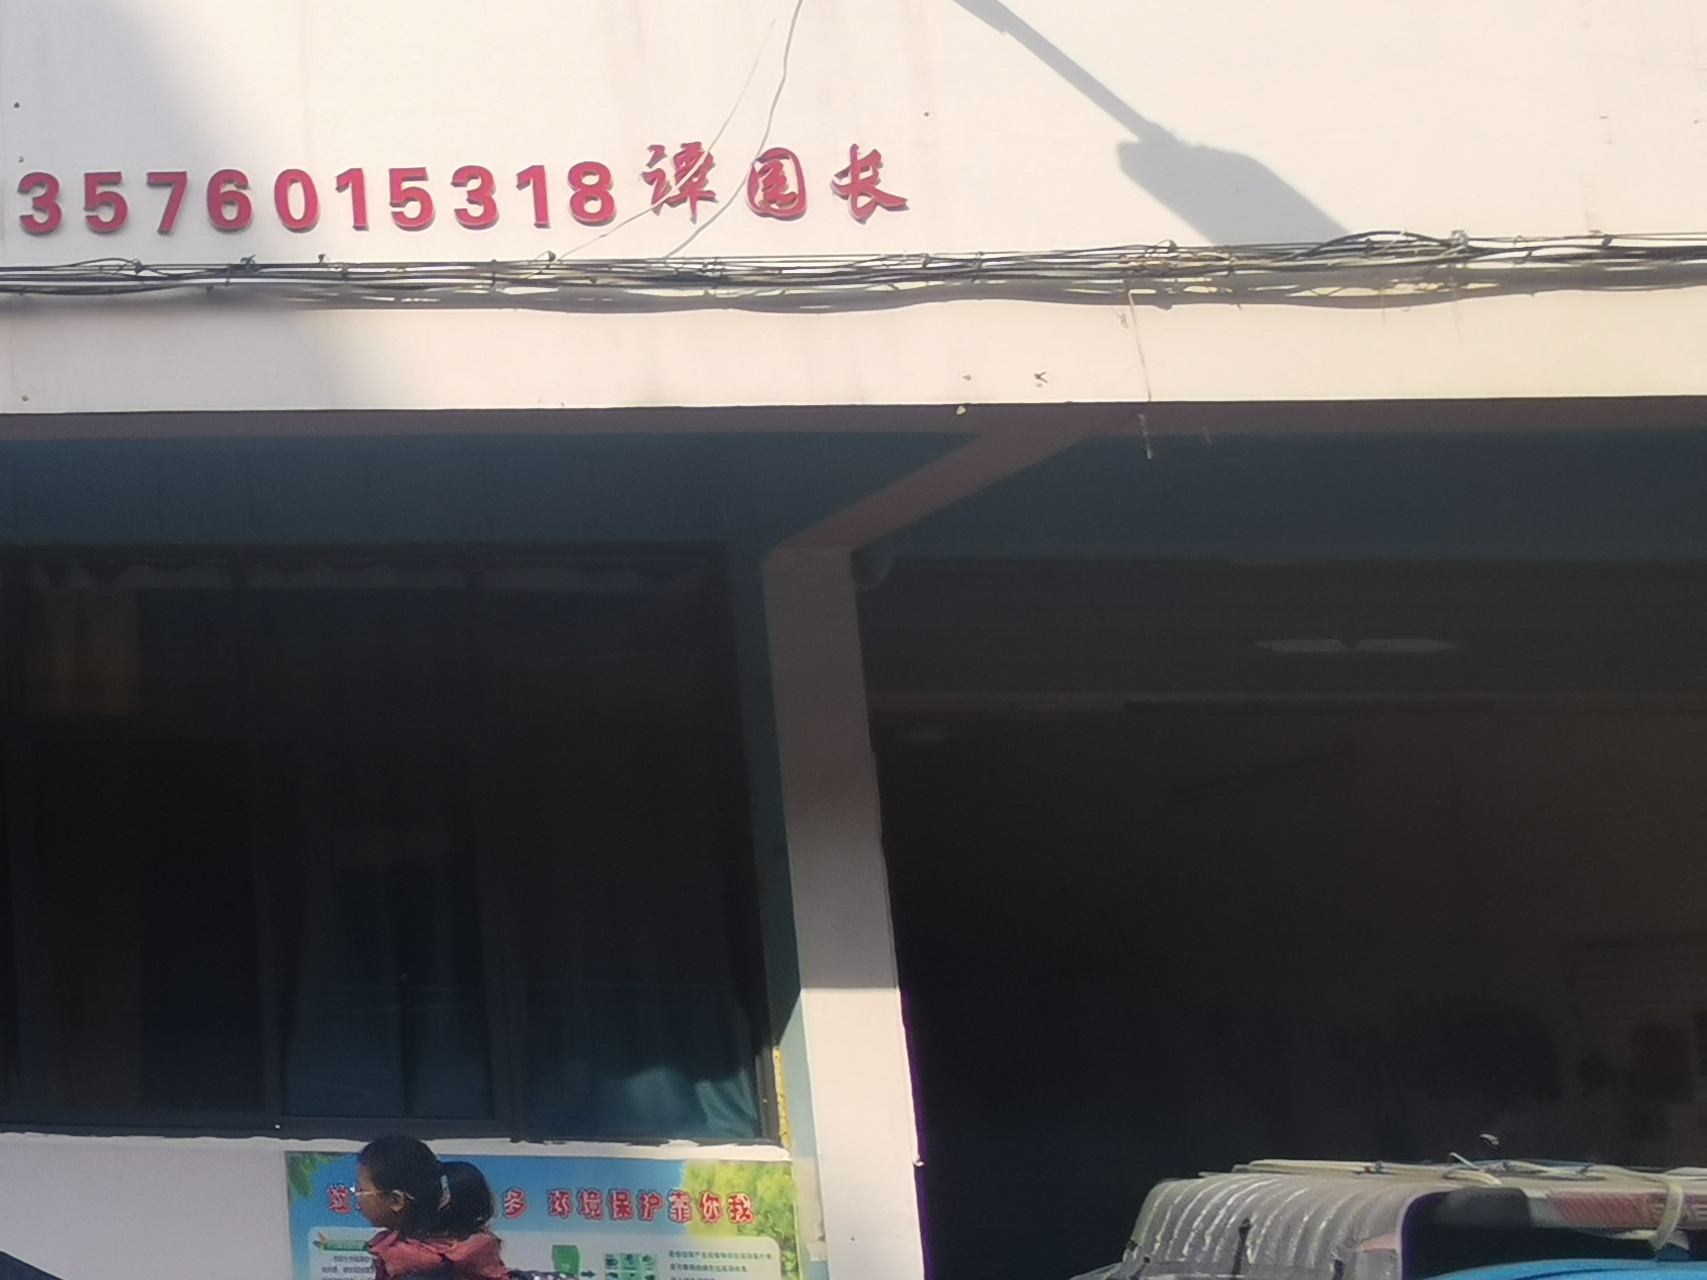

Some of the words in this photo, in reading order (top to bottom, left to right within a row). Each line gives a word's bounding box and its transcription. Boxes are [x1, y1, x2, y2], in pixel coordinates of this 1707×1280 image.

[547, 1187, 755, 1224] 环境保护靠你我
